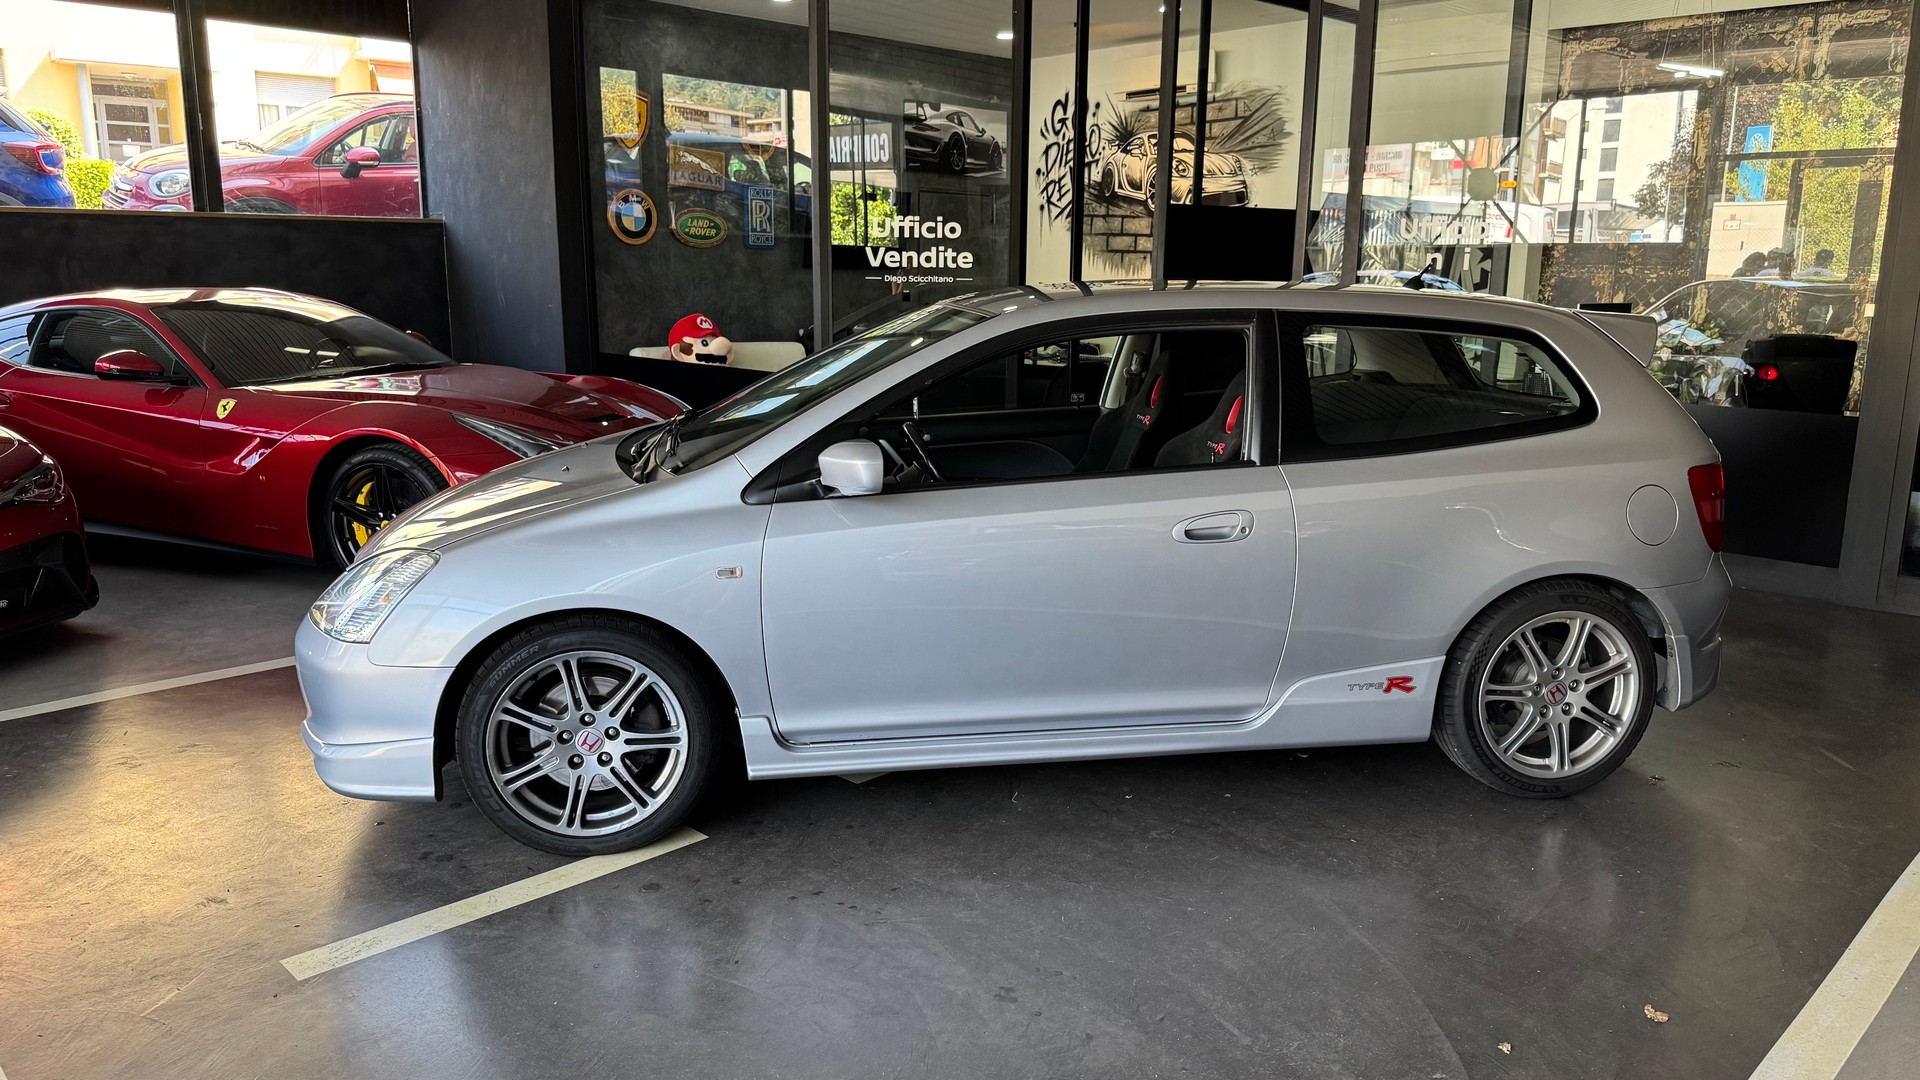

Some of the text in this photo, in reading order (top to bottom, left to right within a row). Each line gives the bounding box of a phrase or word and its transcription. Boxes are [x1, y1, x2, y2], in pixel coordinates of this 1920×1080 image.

[673, 170, 722, 186] JAGUAR
[750, 188, 772, 198] ROLLS
[617, 194, 650, 210] BMW
[872, 215, 962, 239] Ufficio
[751, 235, 773, 244] ROYCE
[865, 246, 974, 269] Vendite
[884, 274, 954, 283] Diego Scicchitano
[488, 644, 540, 689] SUMMER
[1348, 676, 1417, 694] TYPE R
